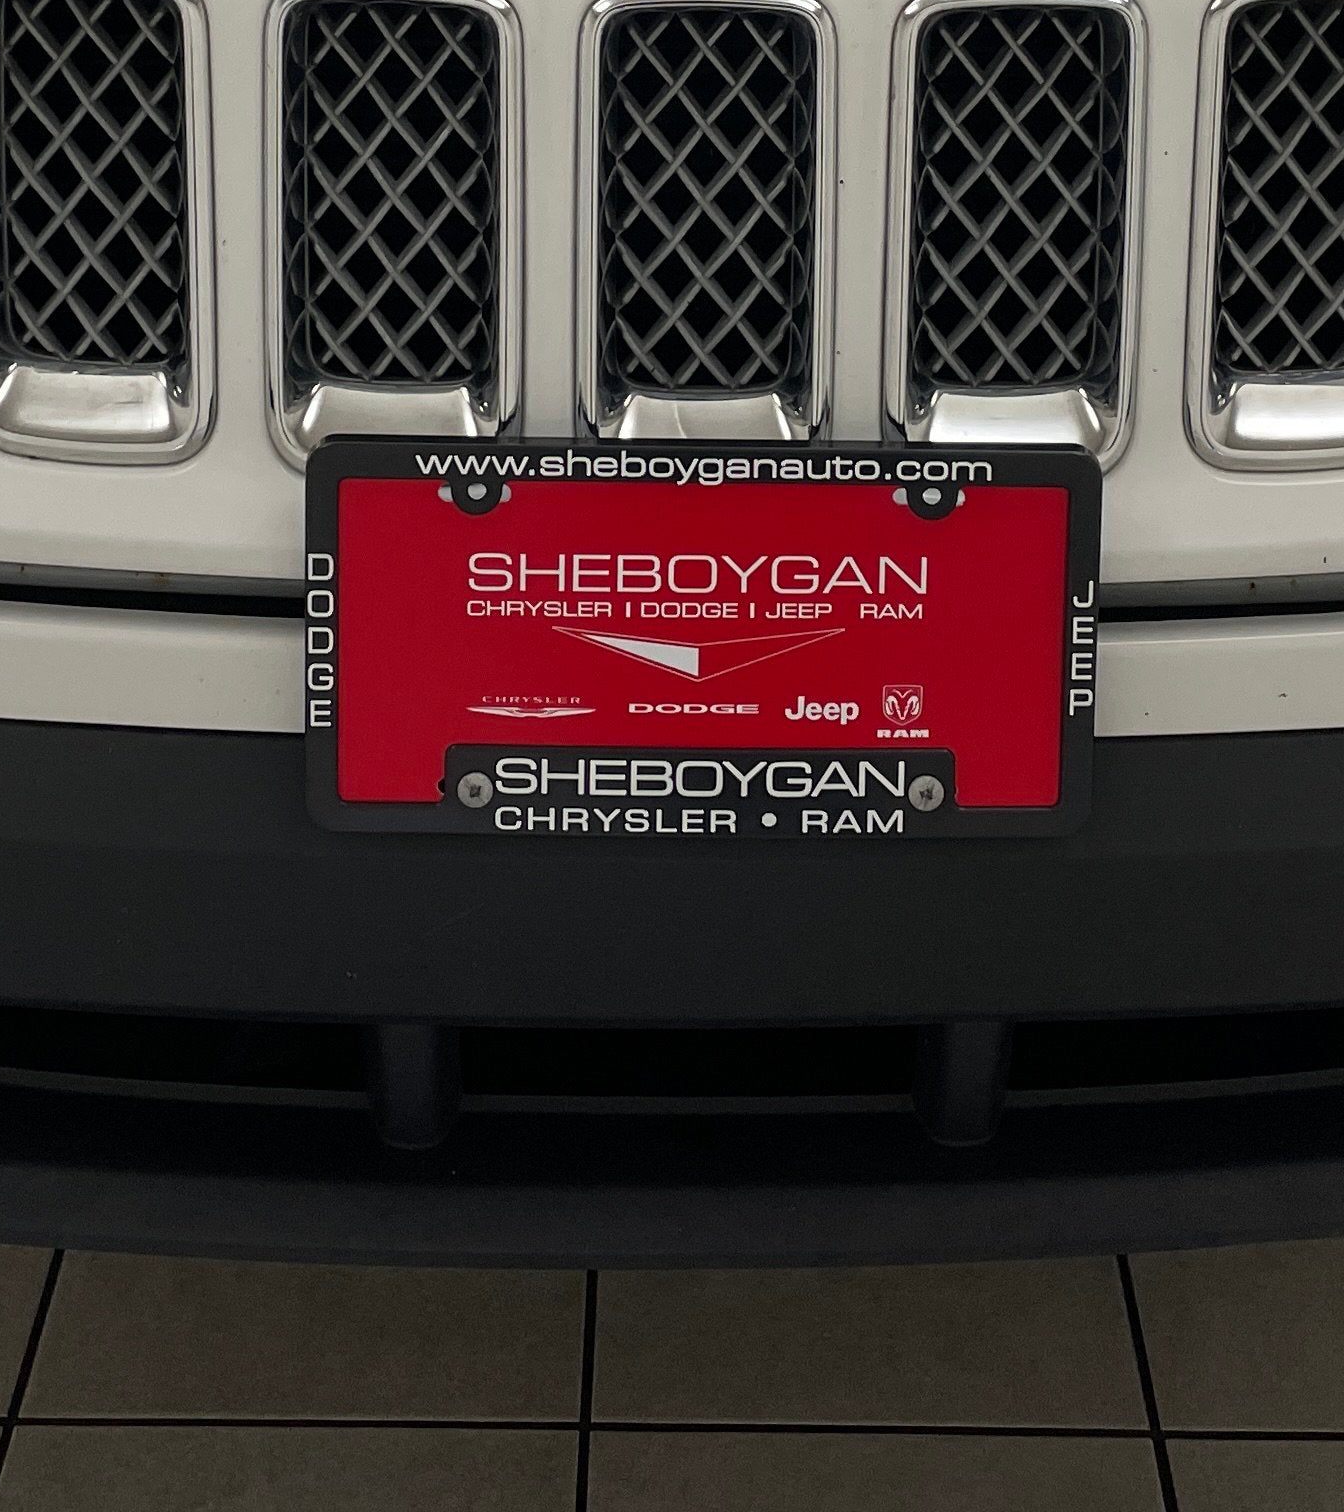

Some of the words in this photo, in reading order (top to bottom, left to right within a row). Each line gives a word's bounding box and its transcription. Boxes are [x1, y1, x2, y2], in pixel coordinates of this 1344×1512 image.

[414, 449, 993, 486] www.sheboyganauto.com
[467, 552, 929, 596] SHEBOYGAN
[466, 600, 612, 618] CHRYSLER
[640, 601, 739, 619] DODGE
[765, 602, 833, 620] JEEP
[859, 602, 924, 620] RAM
[306, 552, 335, 728] DODGE
[1067, 580, 1095, 717] JEEP
[481, 695, 582, 705] CHRYSLER
[628, 703, 760, 715] DODGE
[784, 695, 860, 726] Jeep
[876, 728, 930, 739] RAM
[494, 756, 906, 799] SHEBOYGAN
[494, 805, 738, 834] CHRYSLER
[801, 809, 905, 834] RAM
